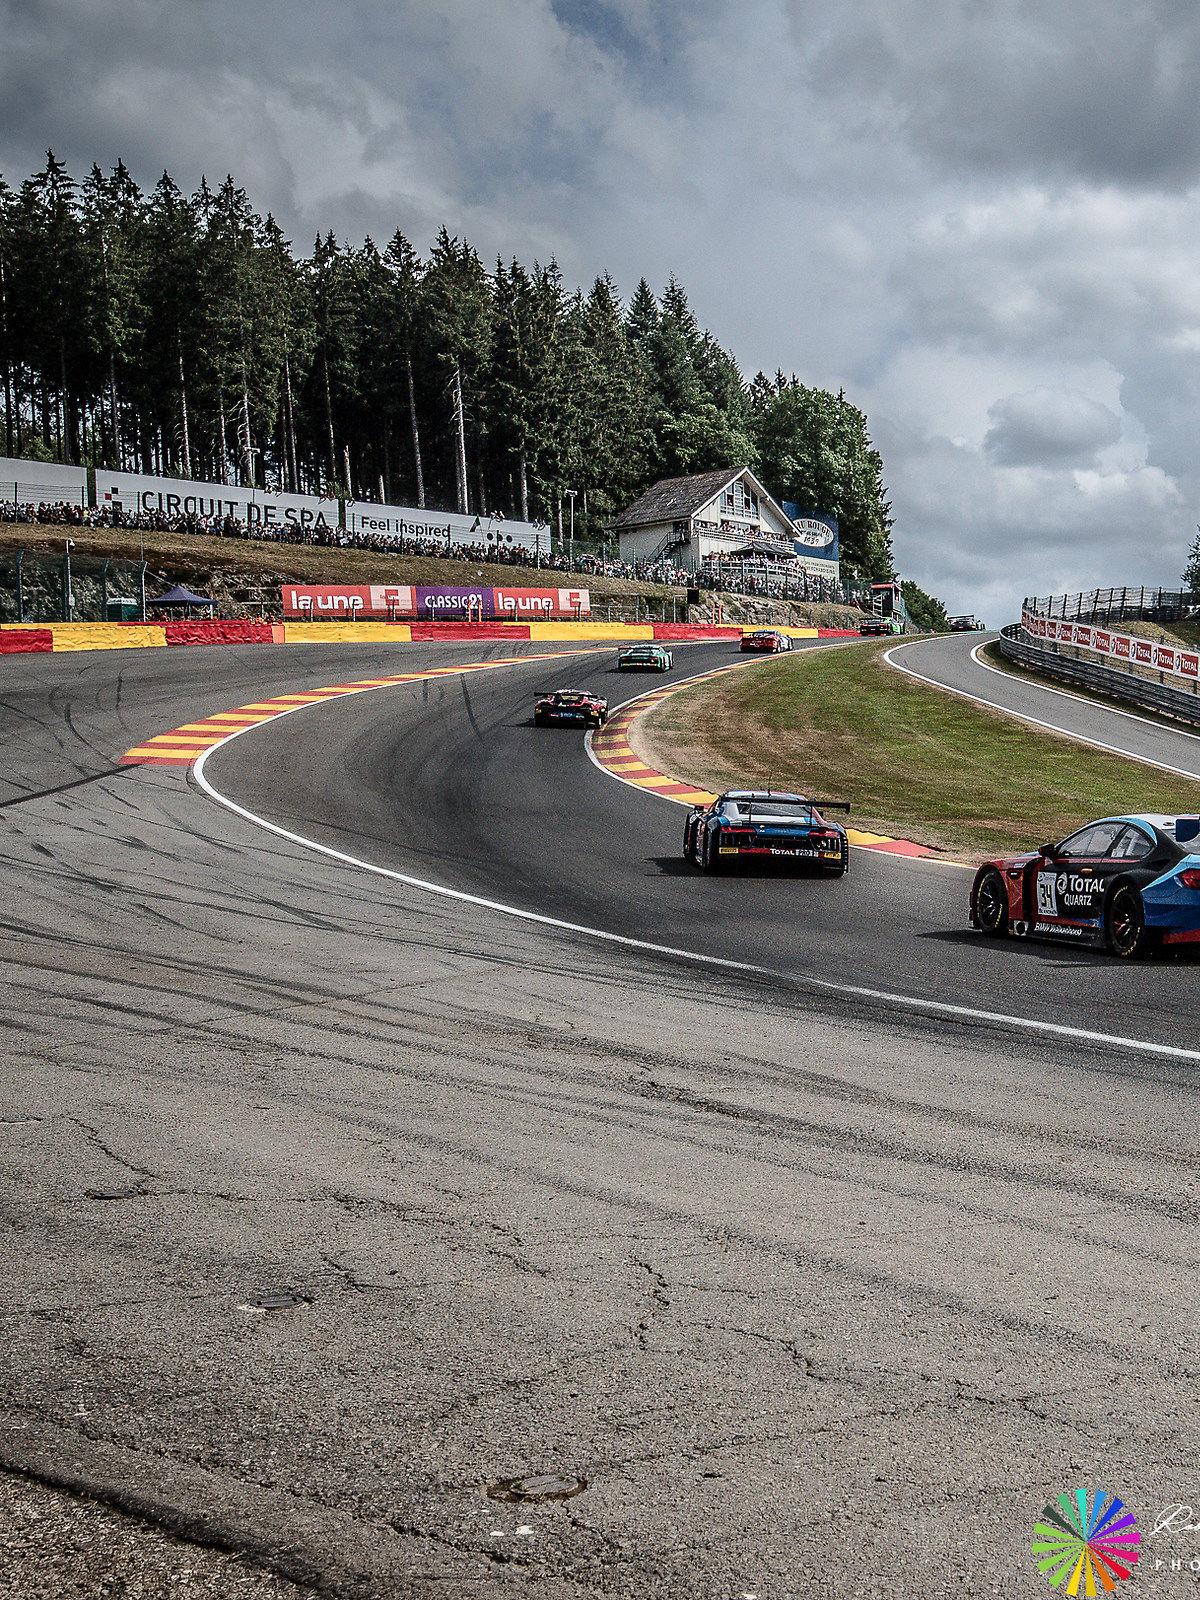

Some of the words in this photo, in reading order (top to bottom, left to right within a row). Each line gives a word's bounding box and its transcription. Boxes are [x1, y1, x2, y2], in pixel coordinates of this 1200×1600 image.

[248, 502, 277, 525] DE
[284, 508, 327, 529] SPA
[361, 517, 389, 531] Feel
[395, 519, 450, 538] inspired
[1096, 632, 1110, 648] TOTAL
[1116, 640, 1130, 653] TOTAL
[1137, 644, 1151, 658] TOTAL
[1158, 651, 1174, 666] TOTAL
[1181, 657, 1198, 672] TOTAL
[770, 848, 795, 856] TOTAL
[1040, 884, 1054, 909] 34
[1064, 894, 1092, 906] QUARTZ
